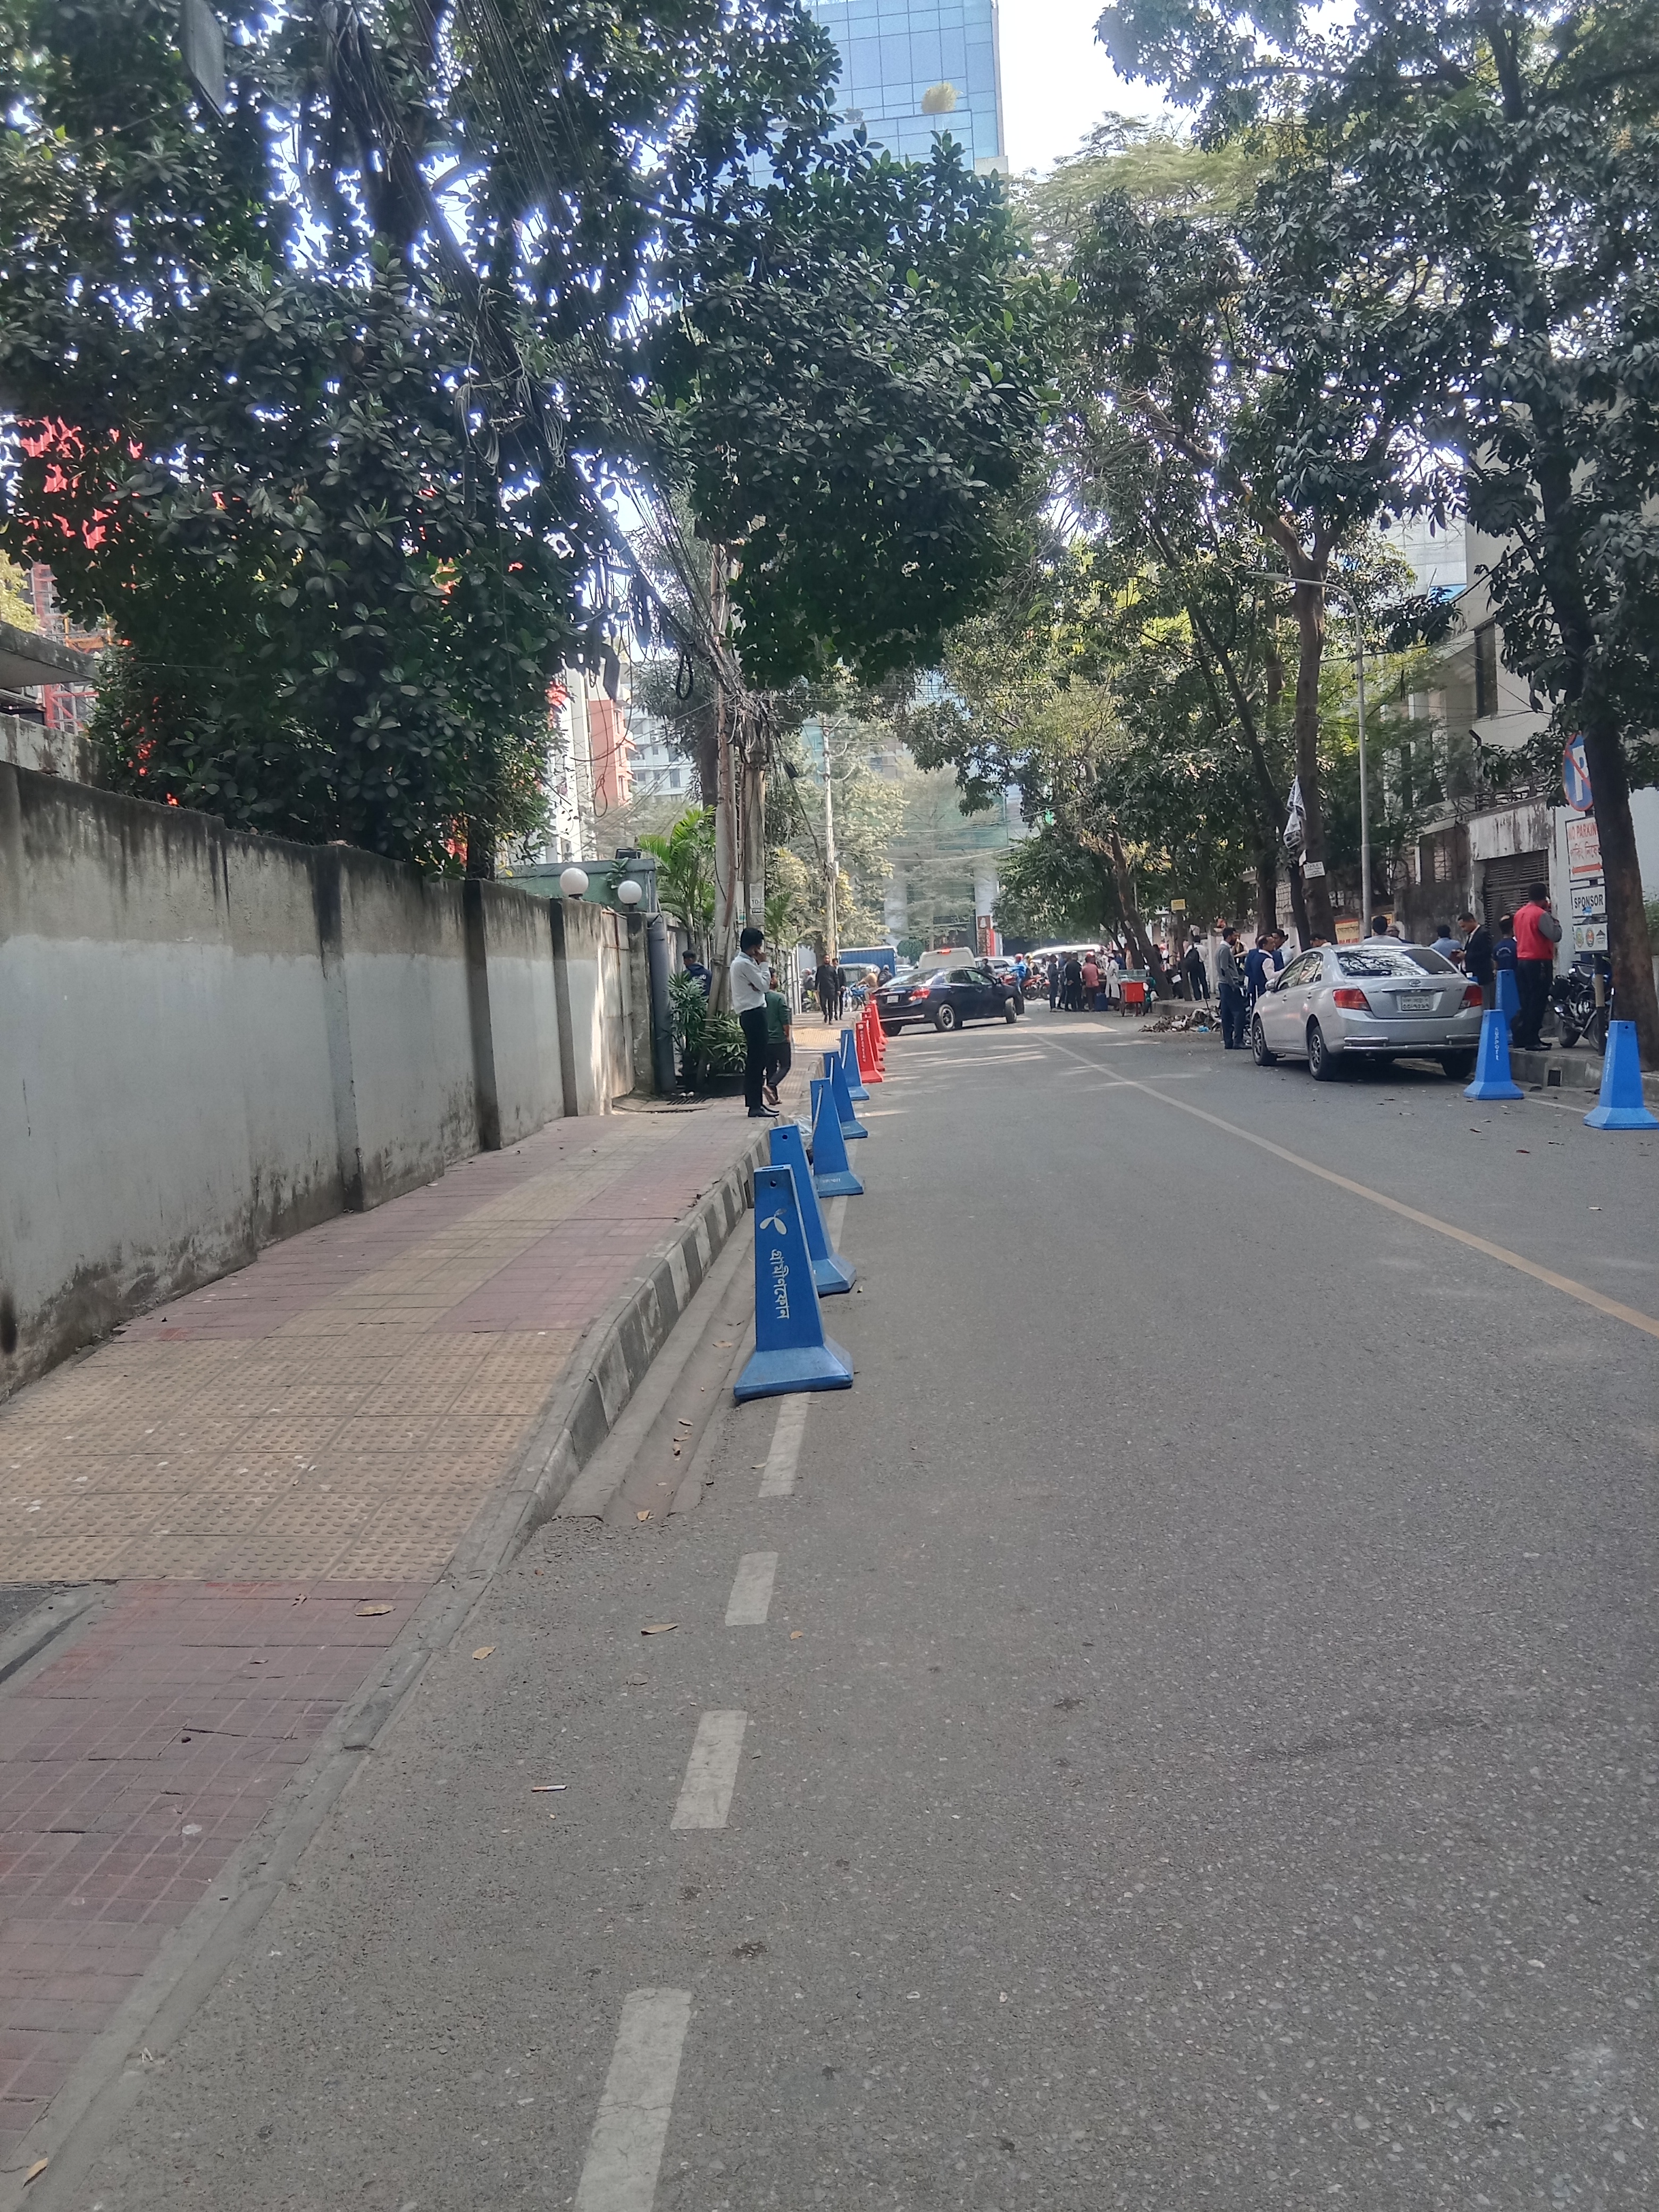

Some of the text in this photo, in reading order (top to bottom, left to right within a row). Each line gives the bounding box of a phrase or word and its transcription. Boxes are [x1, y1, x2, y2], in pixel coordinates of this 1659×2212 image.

[1577, 822, 1597, 838] PARKIN
[1574, 894, 1604, 909] SPONSOR
[769, 1249, 790, 1319] গ্রামীণফোন
